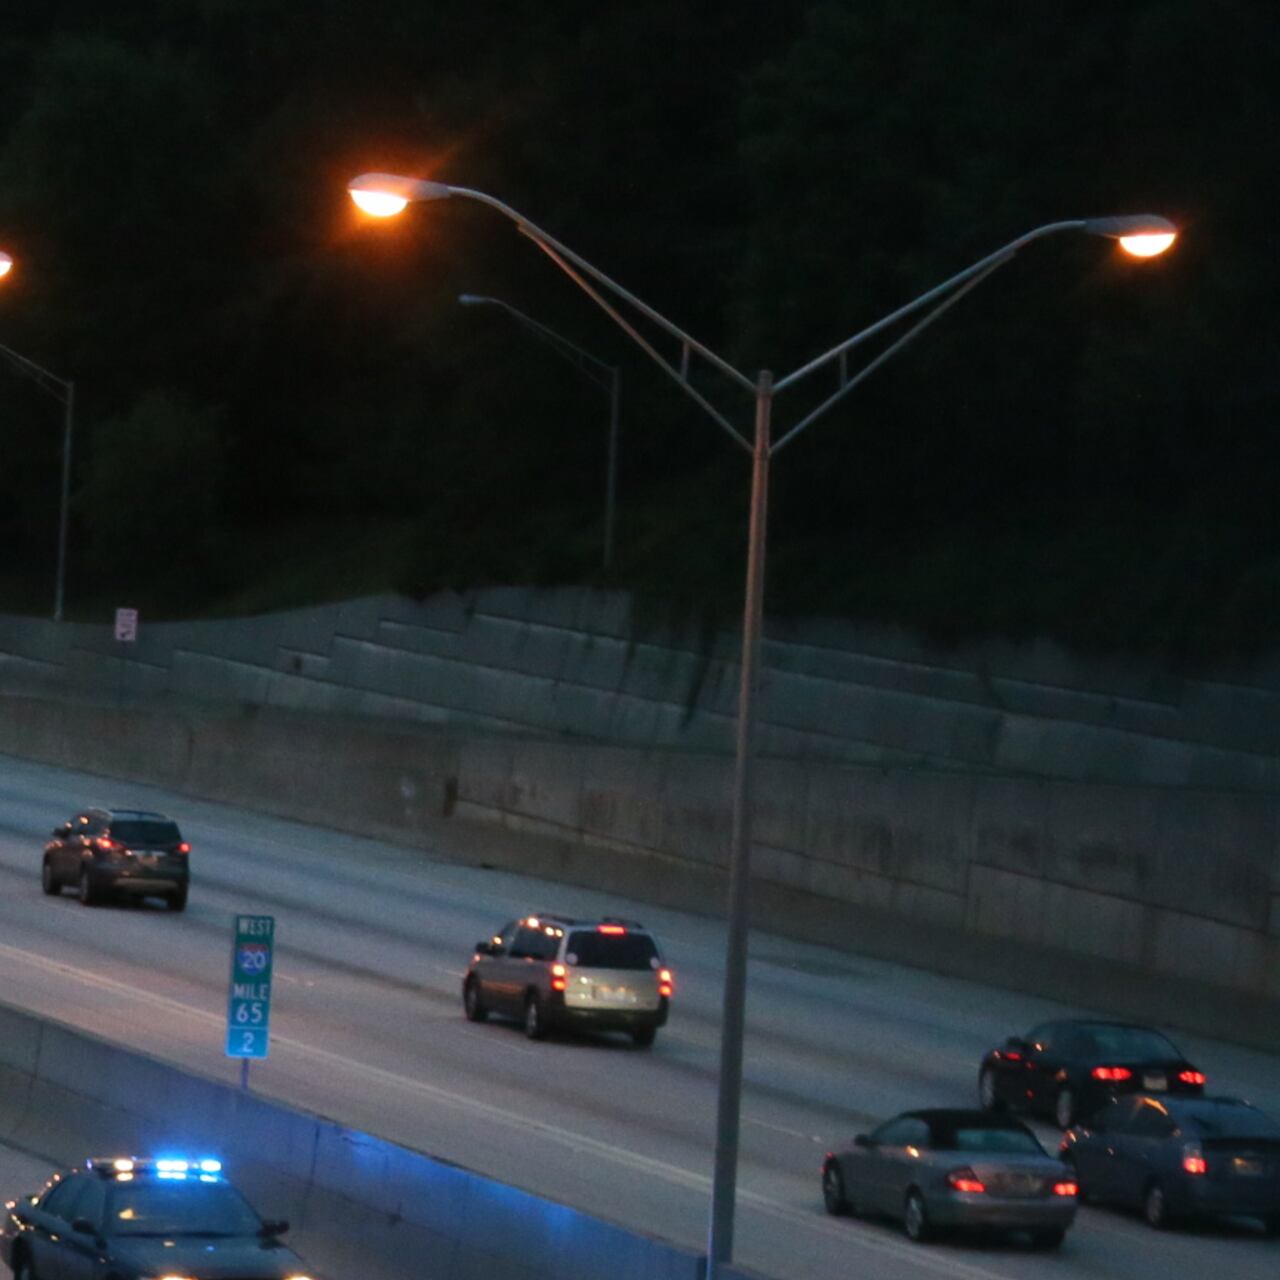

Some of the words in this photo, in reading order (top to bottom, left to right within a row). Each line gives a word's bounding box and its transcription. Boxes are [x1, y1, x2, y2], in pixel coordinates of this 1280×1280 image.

[238, 918, 273, 936] WEST
[242, 951, 266, 970] 20
[233, 982, 269, 1001] MILE
[236, 1002, 263, 1023] 65
[240, 1032, 255, 1054] 2
